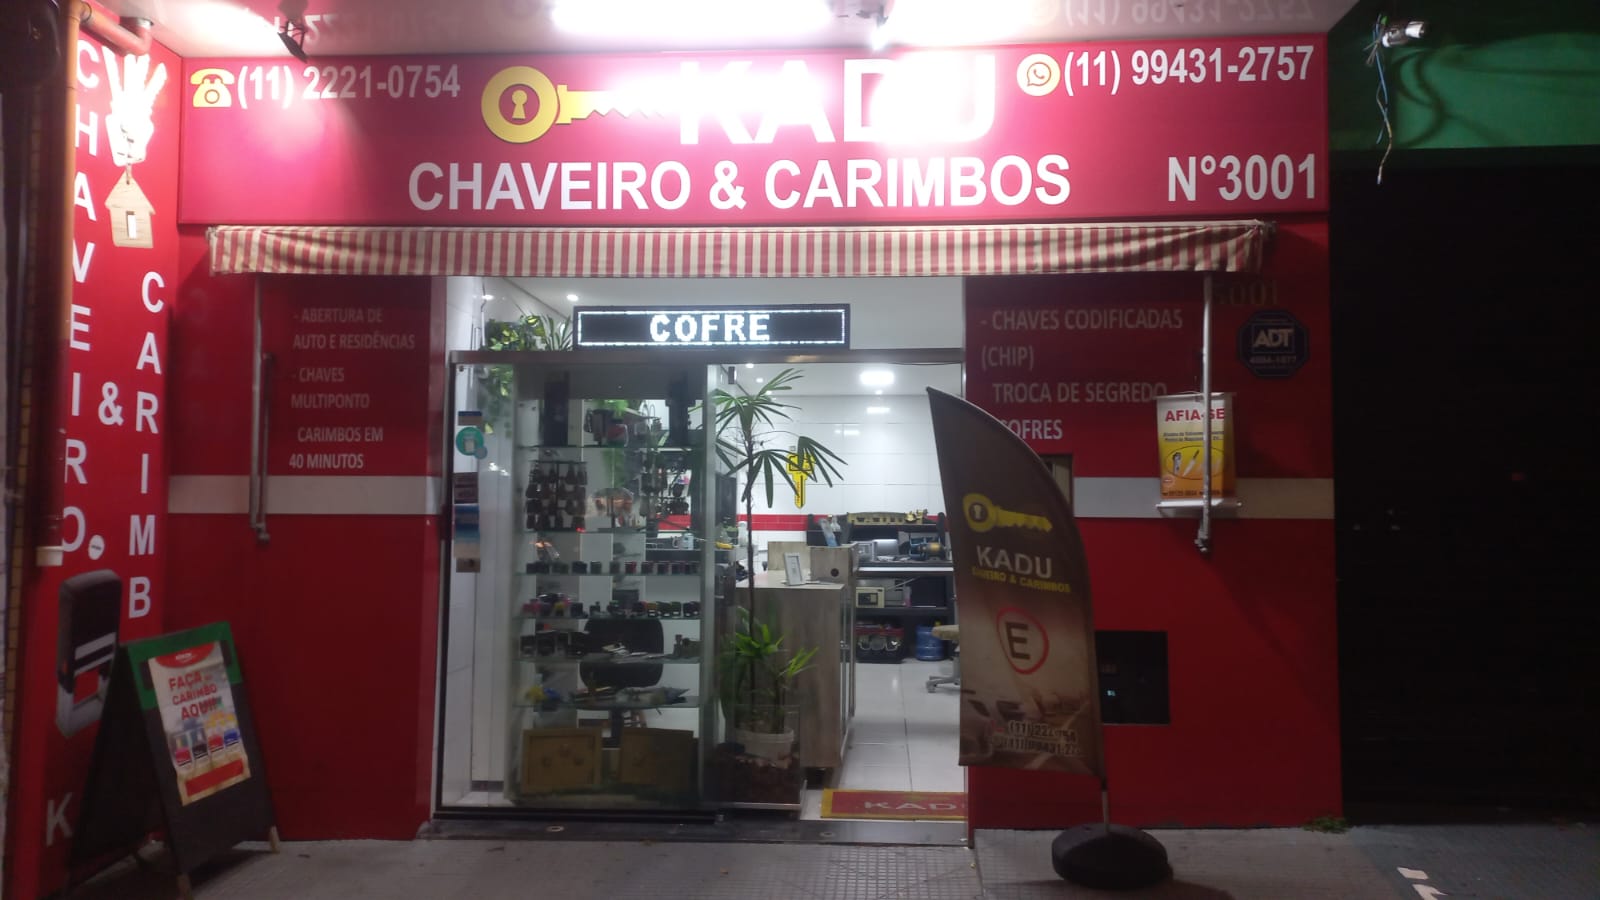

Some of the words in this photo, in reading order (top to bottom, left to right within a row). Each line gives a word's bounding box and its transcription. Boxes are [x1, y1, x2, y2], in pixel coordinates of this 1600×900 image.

[1064, 50, 1121, 96] (11)
[1131, 46, 1315, 85] 99431-2757
[237, 65, 293, 109] (11)
[302, 64, 460, 99] 2221-0754
[679, 54, 996, 145] KADU
[408, 161, 692, 211] CHAVEIRO
[709, 160, 746, 209] &
[764, 155, 1071, 209] CARIMBOS
[301, 308, 364, 323] ABERTURA
[367, 308, 383, 322] DE
[992, 310, 1059, 330] CHAVES
[1064, 309, 1183, 329] CODIFICADAS
[649, 313, 770, 342] COFRE
[1253, 328, 1295, 347] ADT
[293, 334, 327, 349] AUTO
[329, 335, 336, 348] E
[340, 331, 415, 349] RESIDÊNCIAS
[981, 345, 1035, 370] (CHIP)
[299, 367, 345, 383] CHAVES
[291, 394, 370, 409] MULTIPONTO
[993, 383, 1051, 403] TROCA
[1057, 383, 1078, 403] DE
[1085, 382, 1168, 403] SEGREDO
[98, 381, 124, 426] &
[297, 427, 361, 442] CARIMBOS
[364, 427, 384, 442] EM
[289, 454, 304, 469] 40
[307, 453, 364, 469] MINUTOS
[976, 545, 1052, 579] KADU
[1005, 621, 1031, 660] E
[168, 671, 203, 691] FAÇA
[172, 684, 217, 705] CARIMBO
[864, 800, 966, 810] KAD
